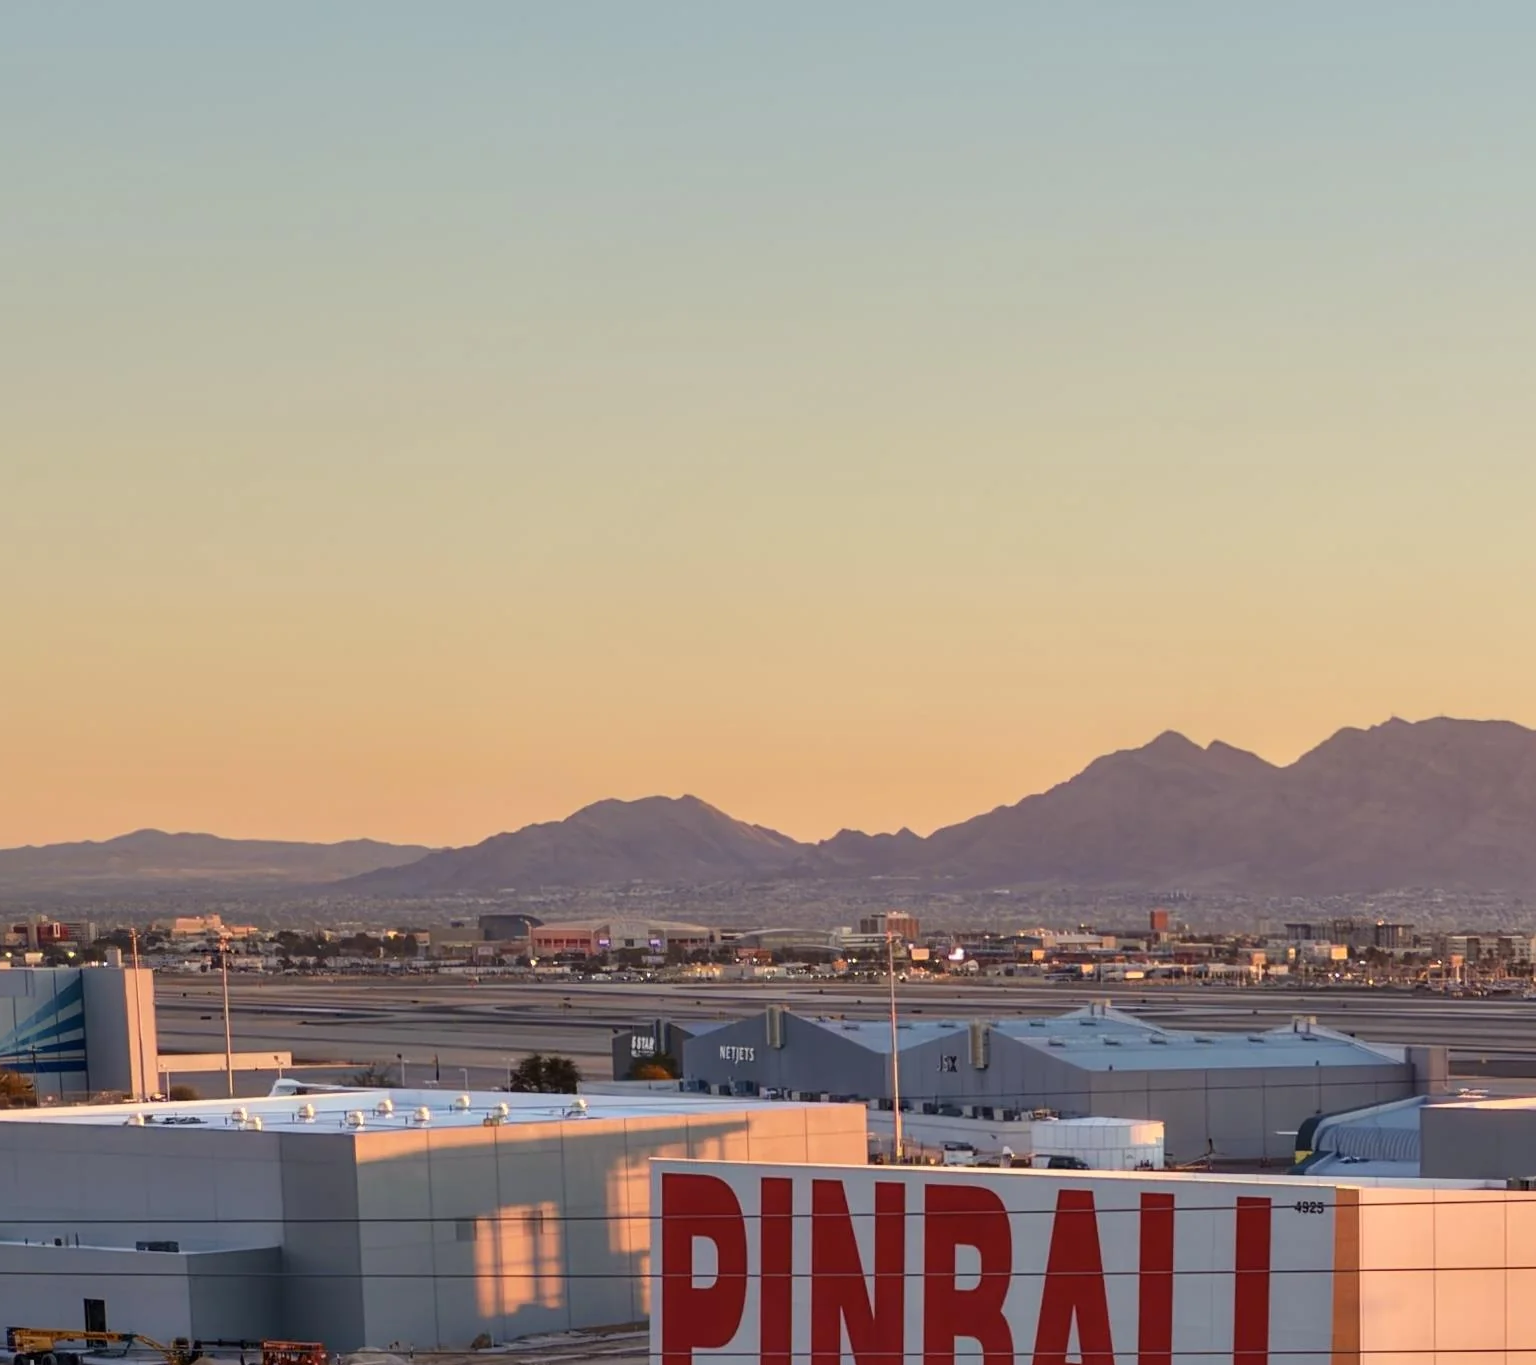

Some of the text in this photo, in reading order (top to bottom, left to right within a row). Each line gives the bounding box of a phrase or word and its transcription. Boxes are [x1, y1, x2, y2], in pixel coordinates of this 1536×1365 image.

[637, 1036, 655, 1051] STAR
[719, 1045, 755, 1064] NETJETS
[936, 1054, 958, 1073] JSX
